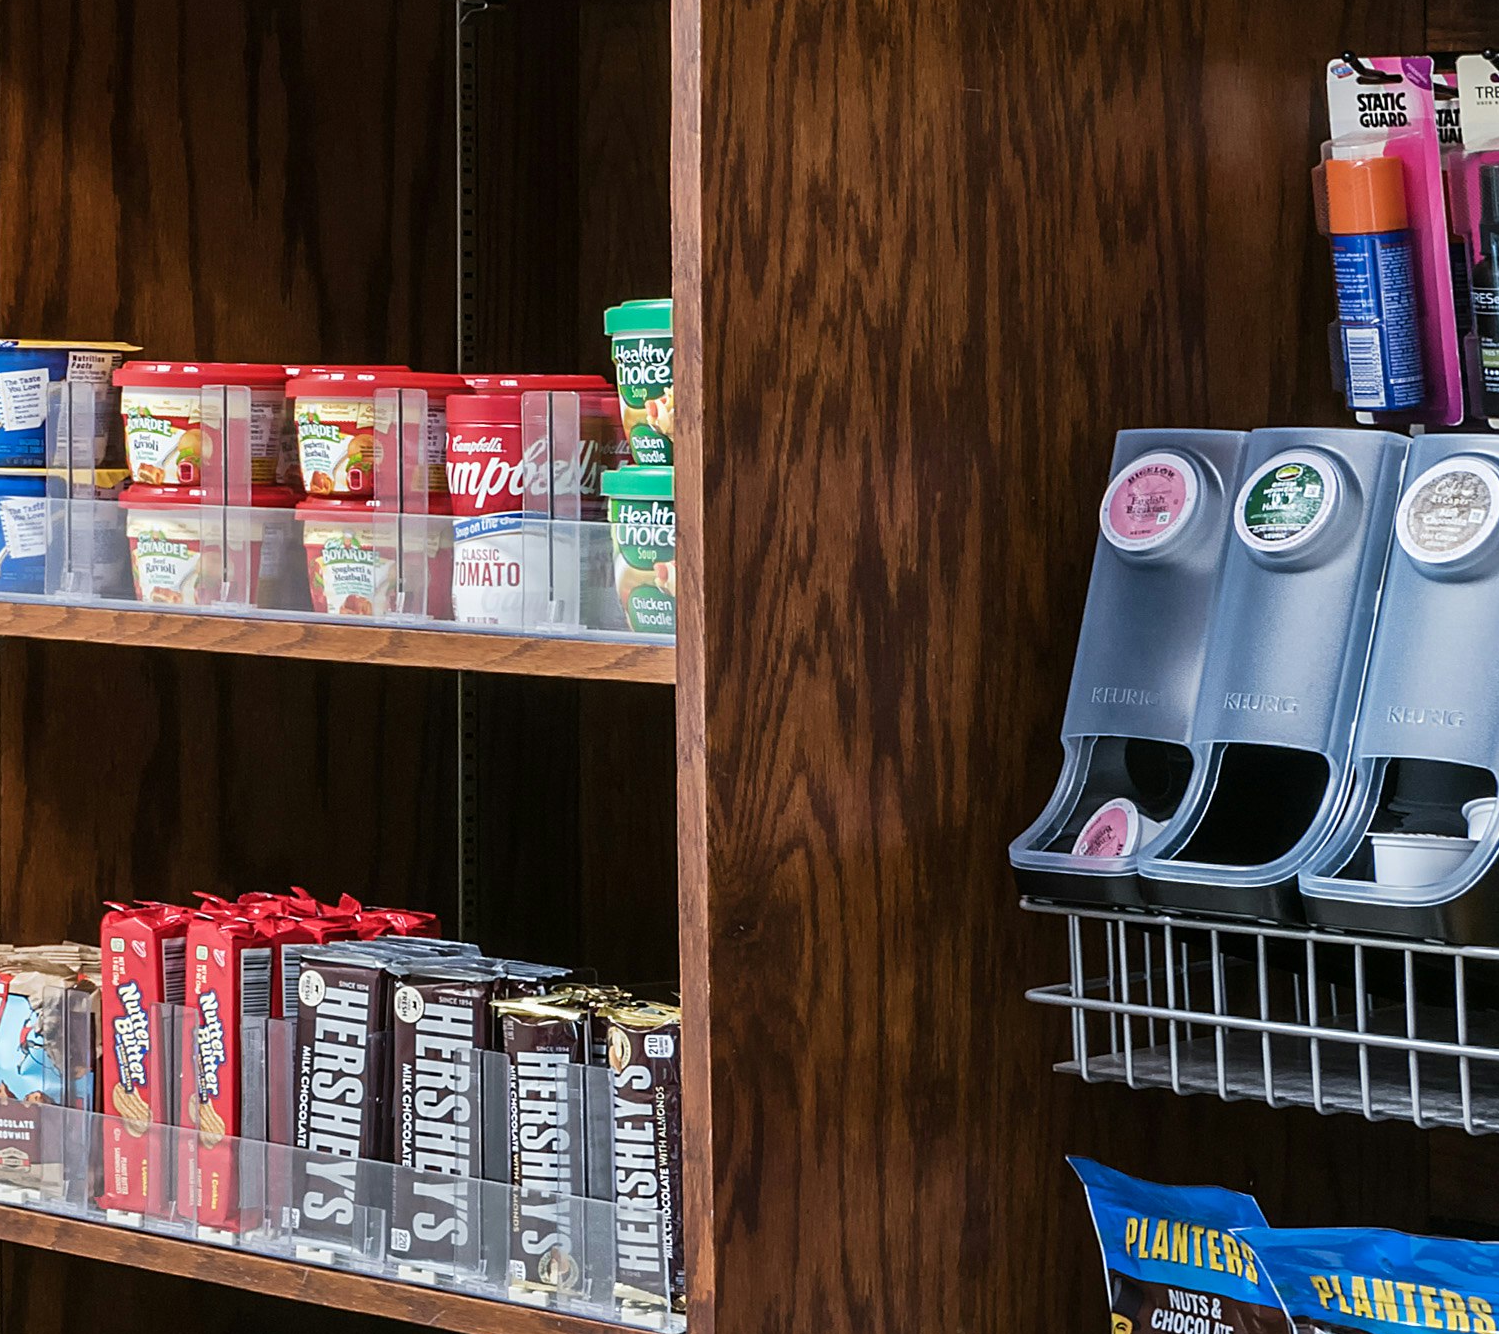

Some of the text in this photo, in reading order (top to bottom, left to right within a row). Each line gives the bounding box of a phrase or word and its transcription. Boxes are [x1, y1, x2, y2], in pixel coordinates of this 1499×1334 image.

[1357, 92, 1407, 112] STATIC
[1360, 112, 1408, 128] GUARD
[72, 354, 105, 364] Nutrition
[615, 338, 674, 365] Healthy
[71, 362, 94, 370] Facts
[617, 364, 673, 385] Choice
[4, 375, 42, 387] The Taste
[8, 383, 41, 393] You Love
[631, 386, 647, 399] Soup
[133, 440, 159, 452] Ravioli
[632, 436, 665, 450] Chicken
[637, 450, 667, 463] Noodle
[1131, 495, 1166, 506] English
[454, 517, 499, 540] Soup on the
[137, 540, 189, 561] BOYARDEE
[461, 548, 500, 562] CLASSIC
[637, 548, 657, 561] Soup
[145, 563, 176, 575] Ravioli
[333, 573, 371, 584] Meatballs
[454, 562, 521, 587] TOMATO
[632, 597, 672, 611] Chicken
[1090, 686, 1162, 707] KEURIG
[1223, 692, 1299, 714] KEURIG
[1386, 705, 1466, 729] KEURIG
[338, 980, 356, 990] SINCE
[439, 995, 473, 1006] SINCE 1894
[116, 979, 150, 1057] Nutter
[199, 990, 225, 1063] Nutter
[113, 1017, 147, 1087] Butter
[647, 1036, 659, 1057] 210
[297, 1045, 312, 1148] MILK CHOCOLATE
[303, 987, 370, 1226] HERSHEY'S
[401, 1062, 414, 1168] MILK CHOCOLATE
[412, 1002, 475, 1248] HERSHEY'S
[517, 1051, 572, 1256] HERSHEY'S
[615, 1063, 661, 1273] HERSHEY'S
[655, 1085, 673, 1260] MILK CHOCOLATE WITH ALMONDS
[1125, 1217, 1259, 1285] PLANTERS
[1167, 1288, 1223, 1321] NUTS &
